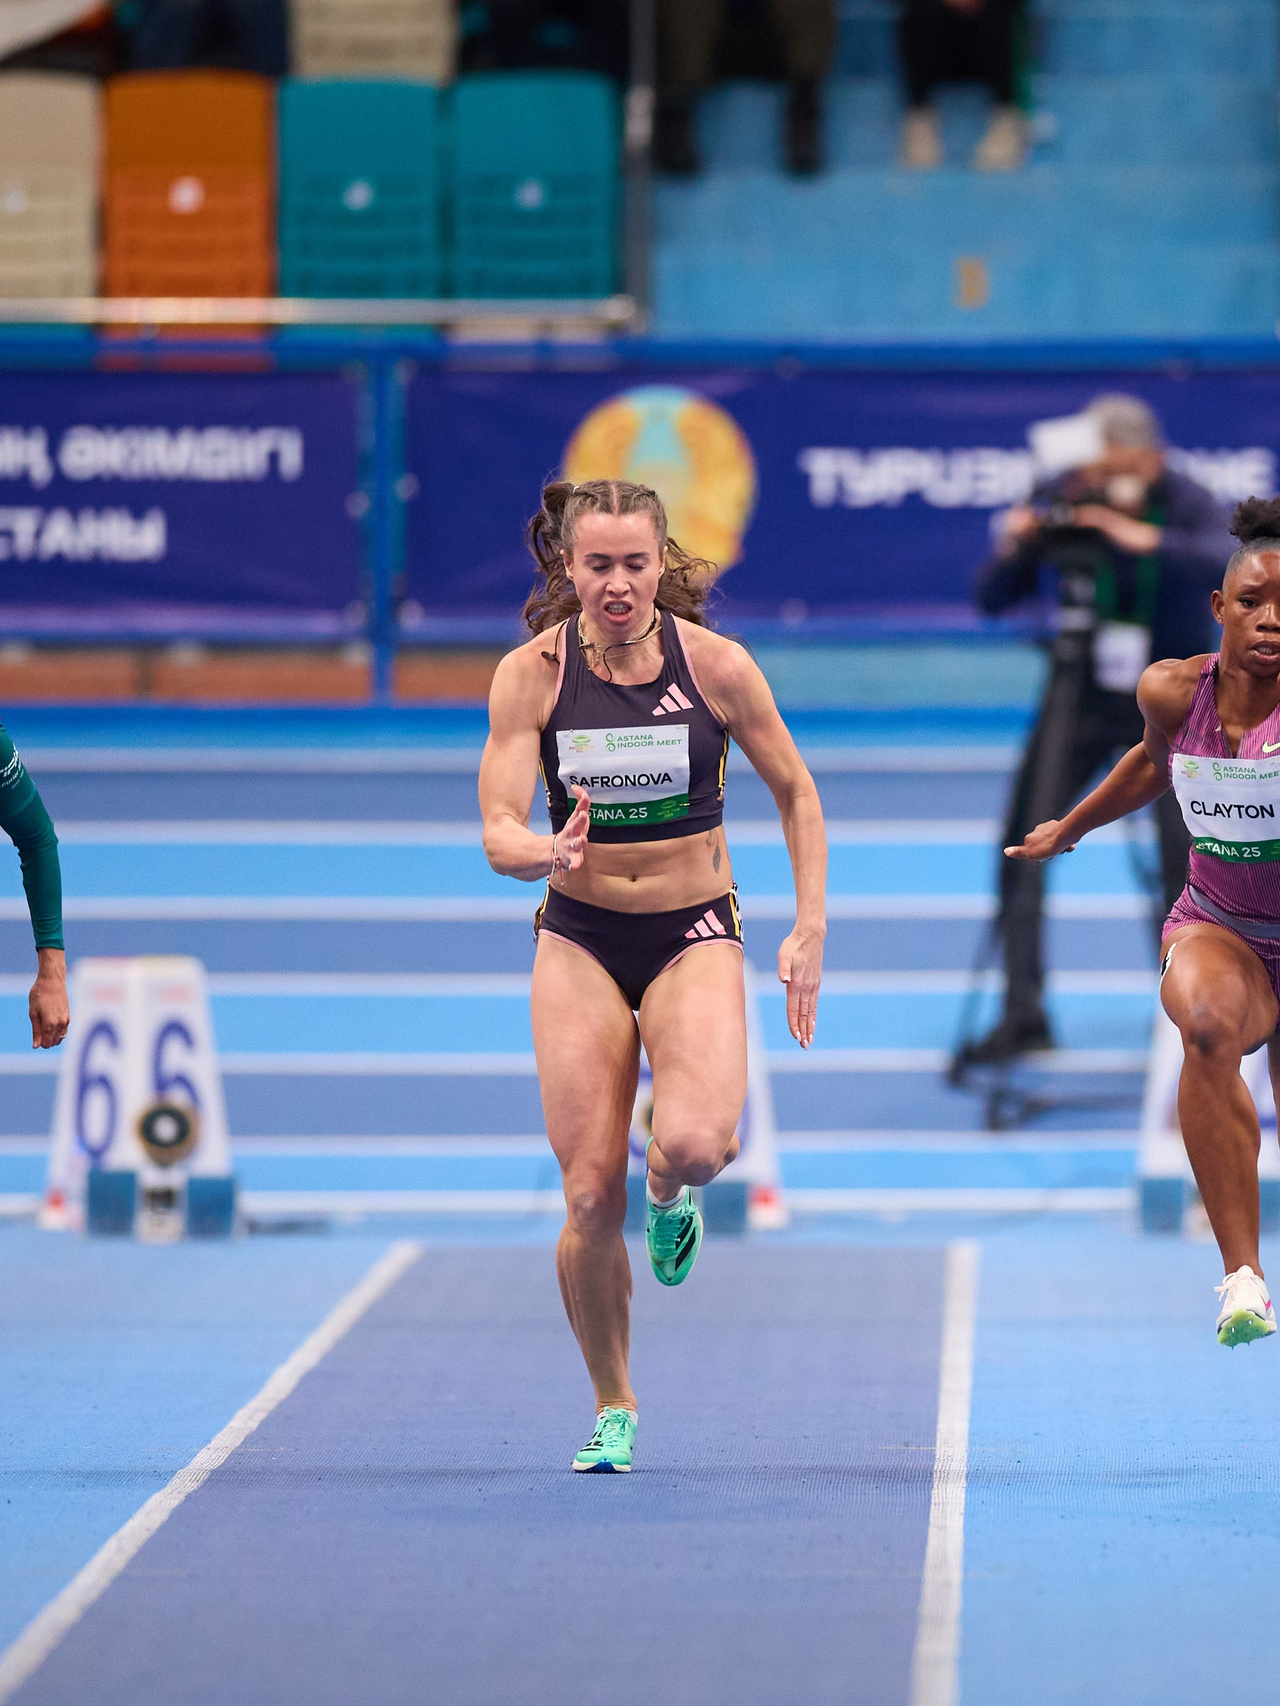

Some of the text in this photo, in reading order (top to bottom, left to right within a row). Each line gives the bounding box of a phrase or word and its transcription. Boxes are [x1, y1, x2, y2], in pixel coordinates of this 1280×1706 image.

[617, 734, 654, 742] ASTANA
[617, 741, 654, 749] INDOOR
[1223, 766, 1256, 774] ASTANA
[569, 773, 673, 788] SAFRONOVA
[629, 807, 648, 819] 25
[1190, 801, 1275, 819] CLAYTON
[1241, 847, 1261, 858] 25
[75, 1019, 119, 1158] 6
